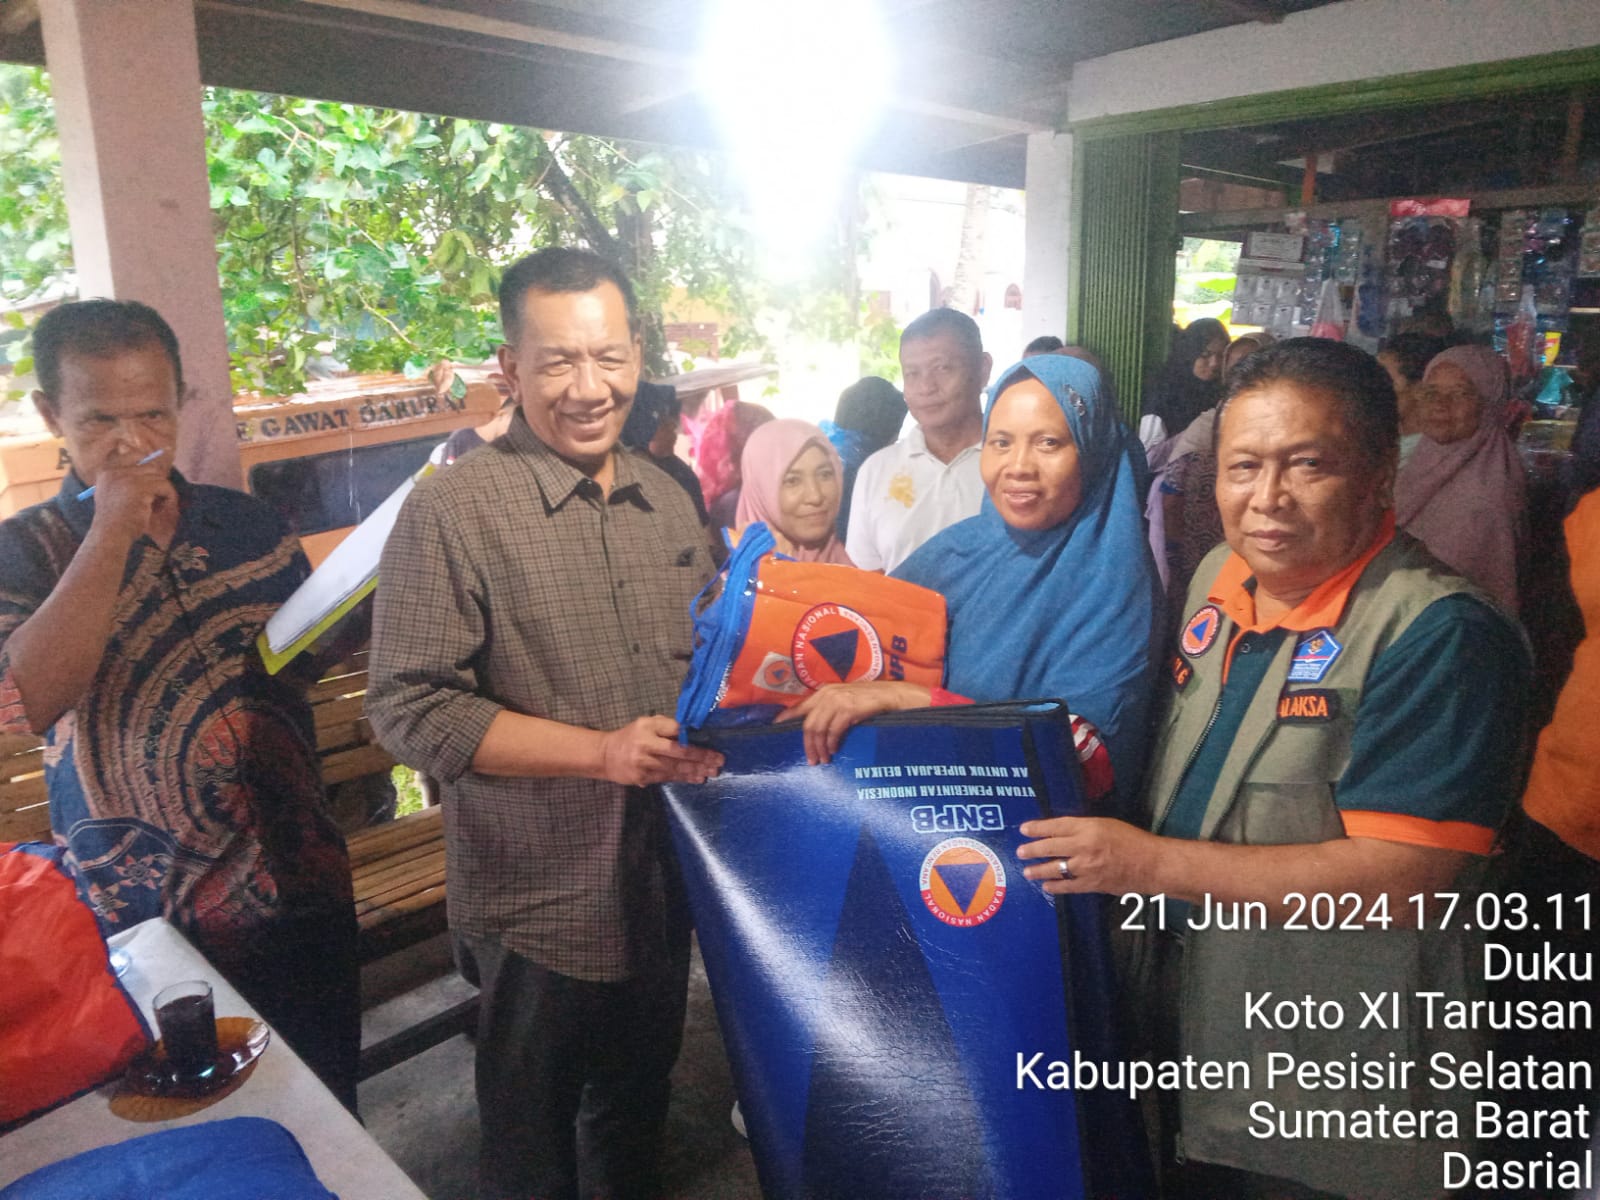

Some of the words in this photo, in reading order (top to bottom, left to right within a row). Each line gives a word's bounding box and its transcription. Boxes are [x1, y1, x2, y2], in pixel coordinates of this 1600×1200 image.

[260, 409, 349, 437] GAWAT
[795, 606, 837, 649] NASIONAL
[855, 766, 902, 779] BELIKAN
[904, 765, 967, 778] DIPERJUAL
[969, 766, 1009, 778] UNTUK
[1011, 767, 1029, 778] AK
[857, 786, 917, 800] INDONESIA
[920, 785, 993, 798] PEMERINTAH
[911, 804, 1004, 833] BNPB
[925, 893, 973, 926] NASIONAL
[976, 890, 1004, 923] BADAN
